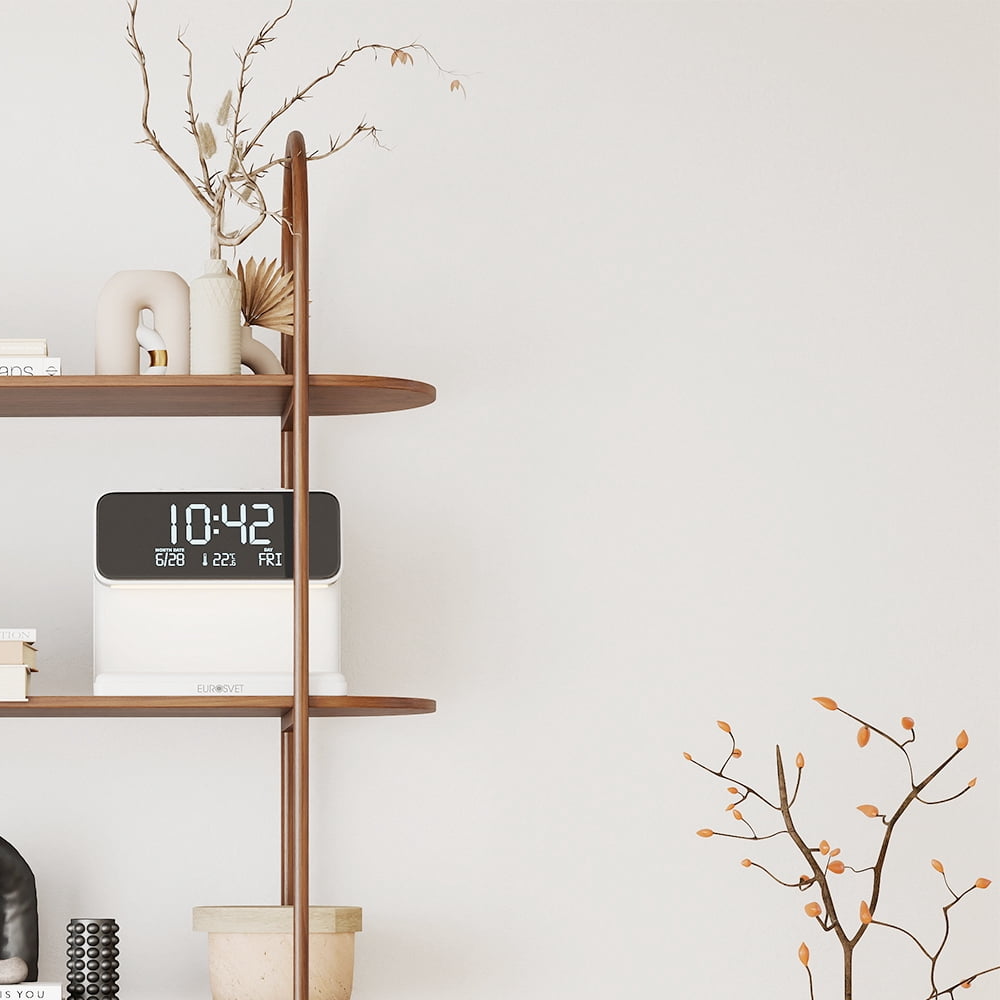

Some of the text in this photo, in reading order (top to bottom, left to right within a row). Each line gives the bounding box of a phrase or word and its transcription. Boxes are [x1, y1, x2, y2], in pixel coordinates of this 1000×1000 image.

[170, 503, 274, 545] 10:42
[155, 552, 185, 567] 6/28
[258, 552, 283, 566] FRI
[0, 990, 11, 999] IS
[17, 990, 46, 999] YOU
